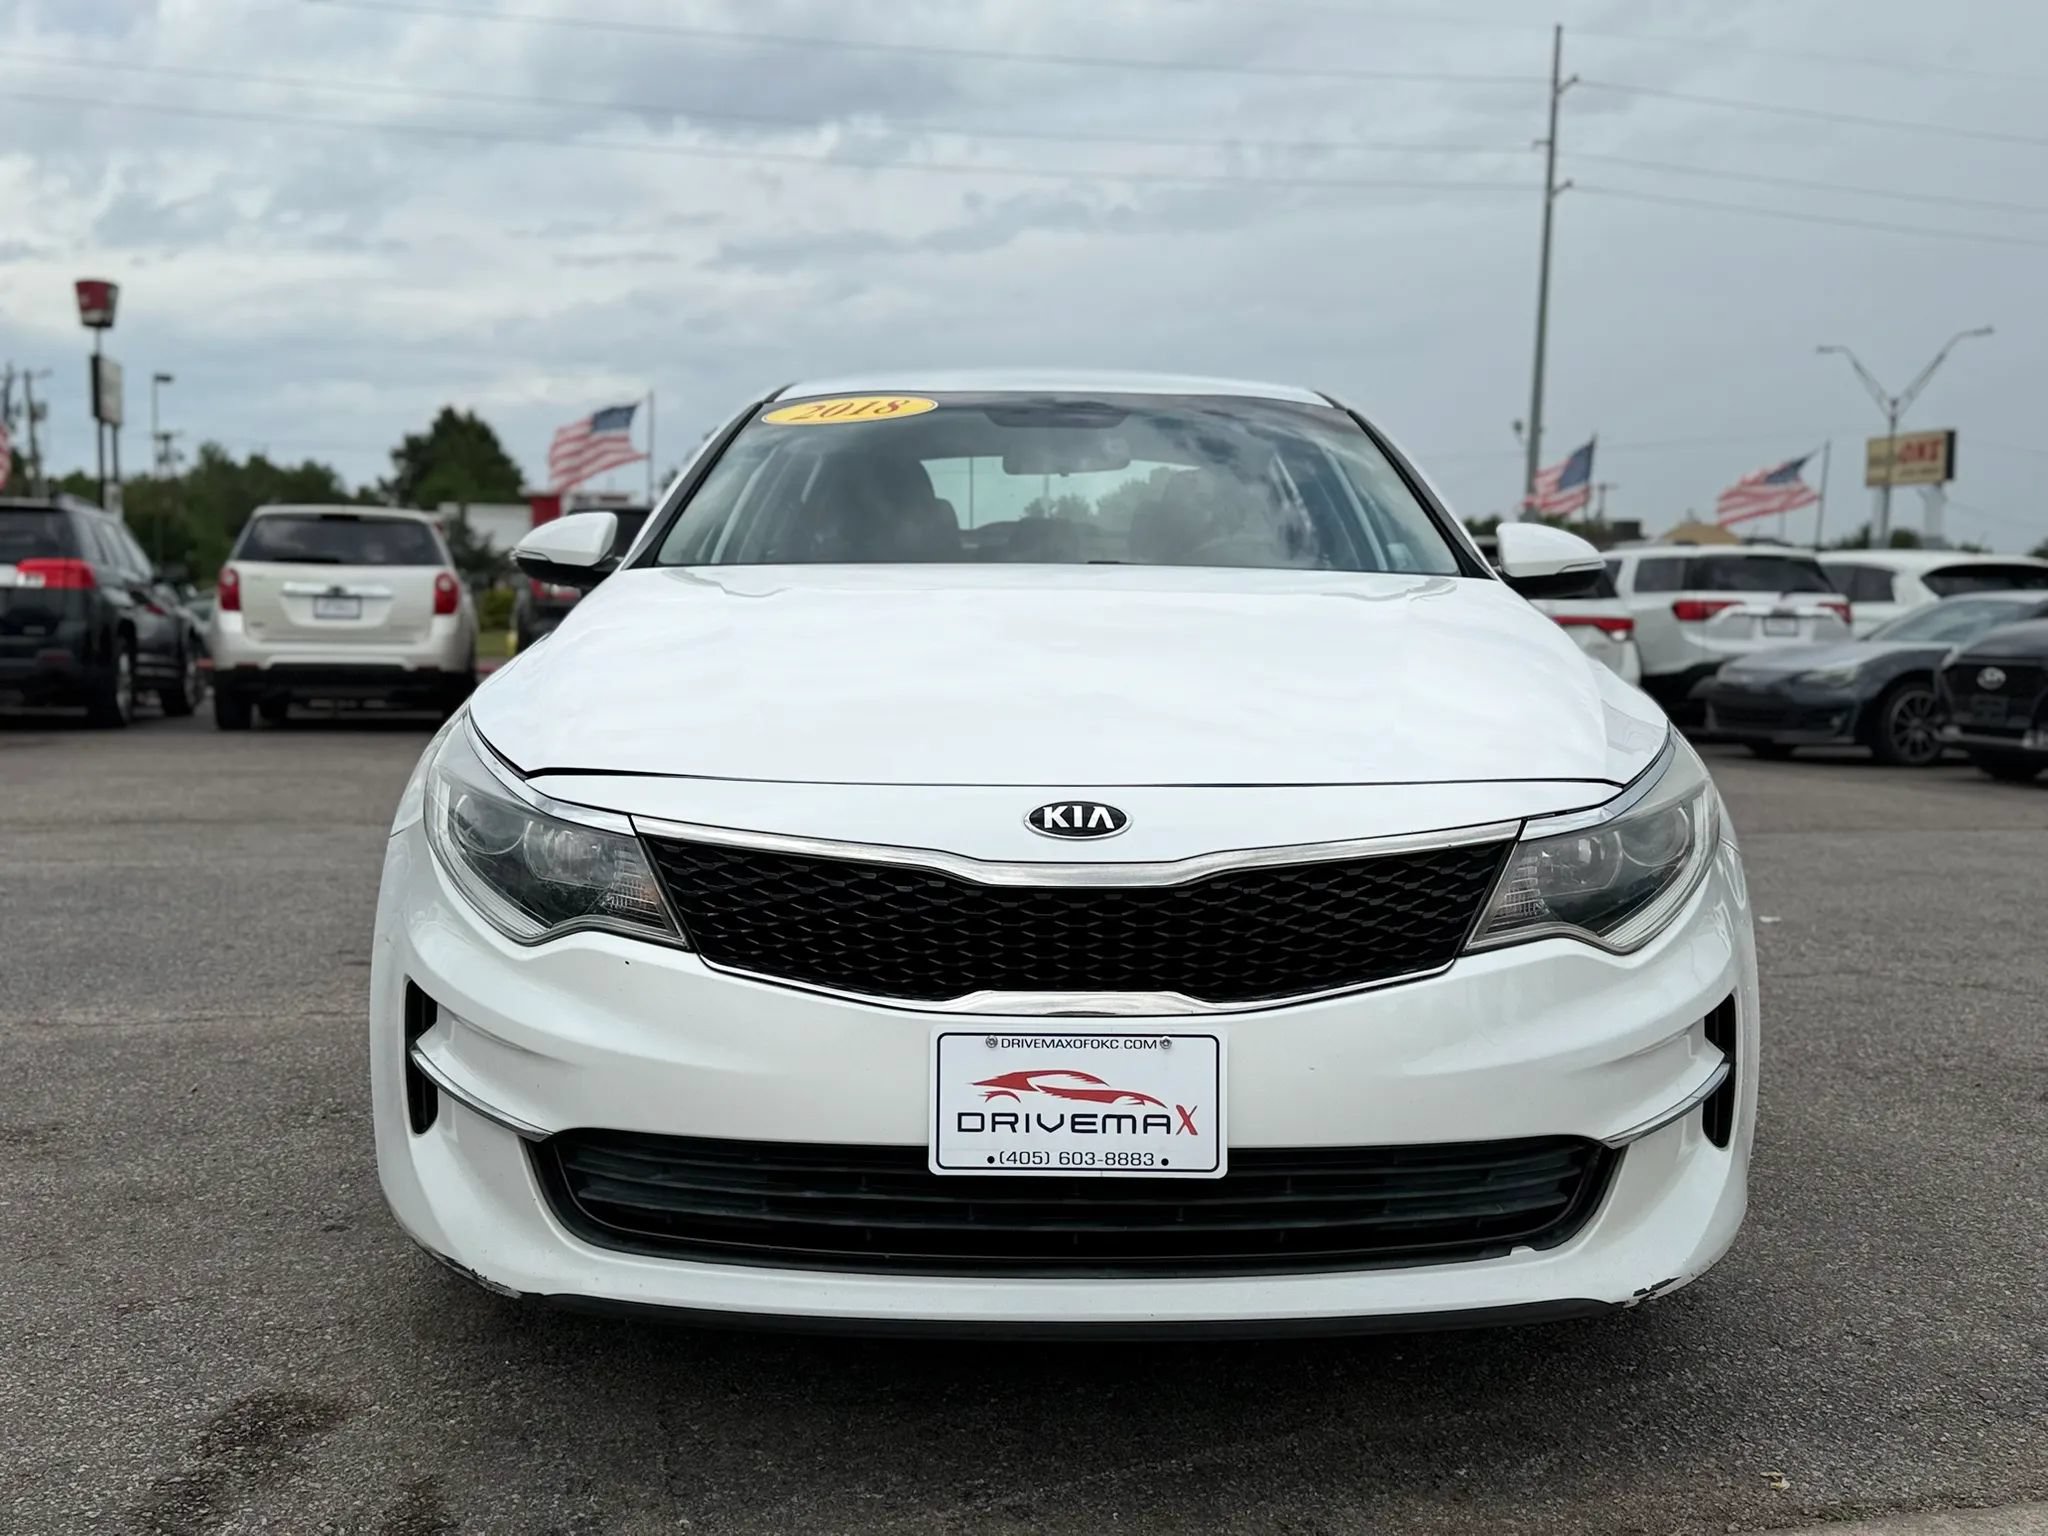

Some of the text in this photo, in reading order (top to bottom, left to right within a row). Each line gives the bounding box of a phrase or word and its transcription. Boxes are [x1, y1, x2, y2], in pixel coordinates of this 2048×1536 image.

[789, 400, 910, 421] 2018
[1043, 805, 1115, 829] KIA
[1000, 1038, 1158, 1050] DRIVEMAXOFOKC.COM
[957, 1104, 1198, 1136] DRIVEMAX
[999, 1151, 1155, 1167] (405) 603-8883
